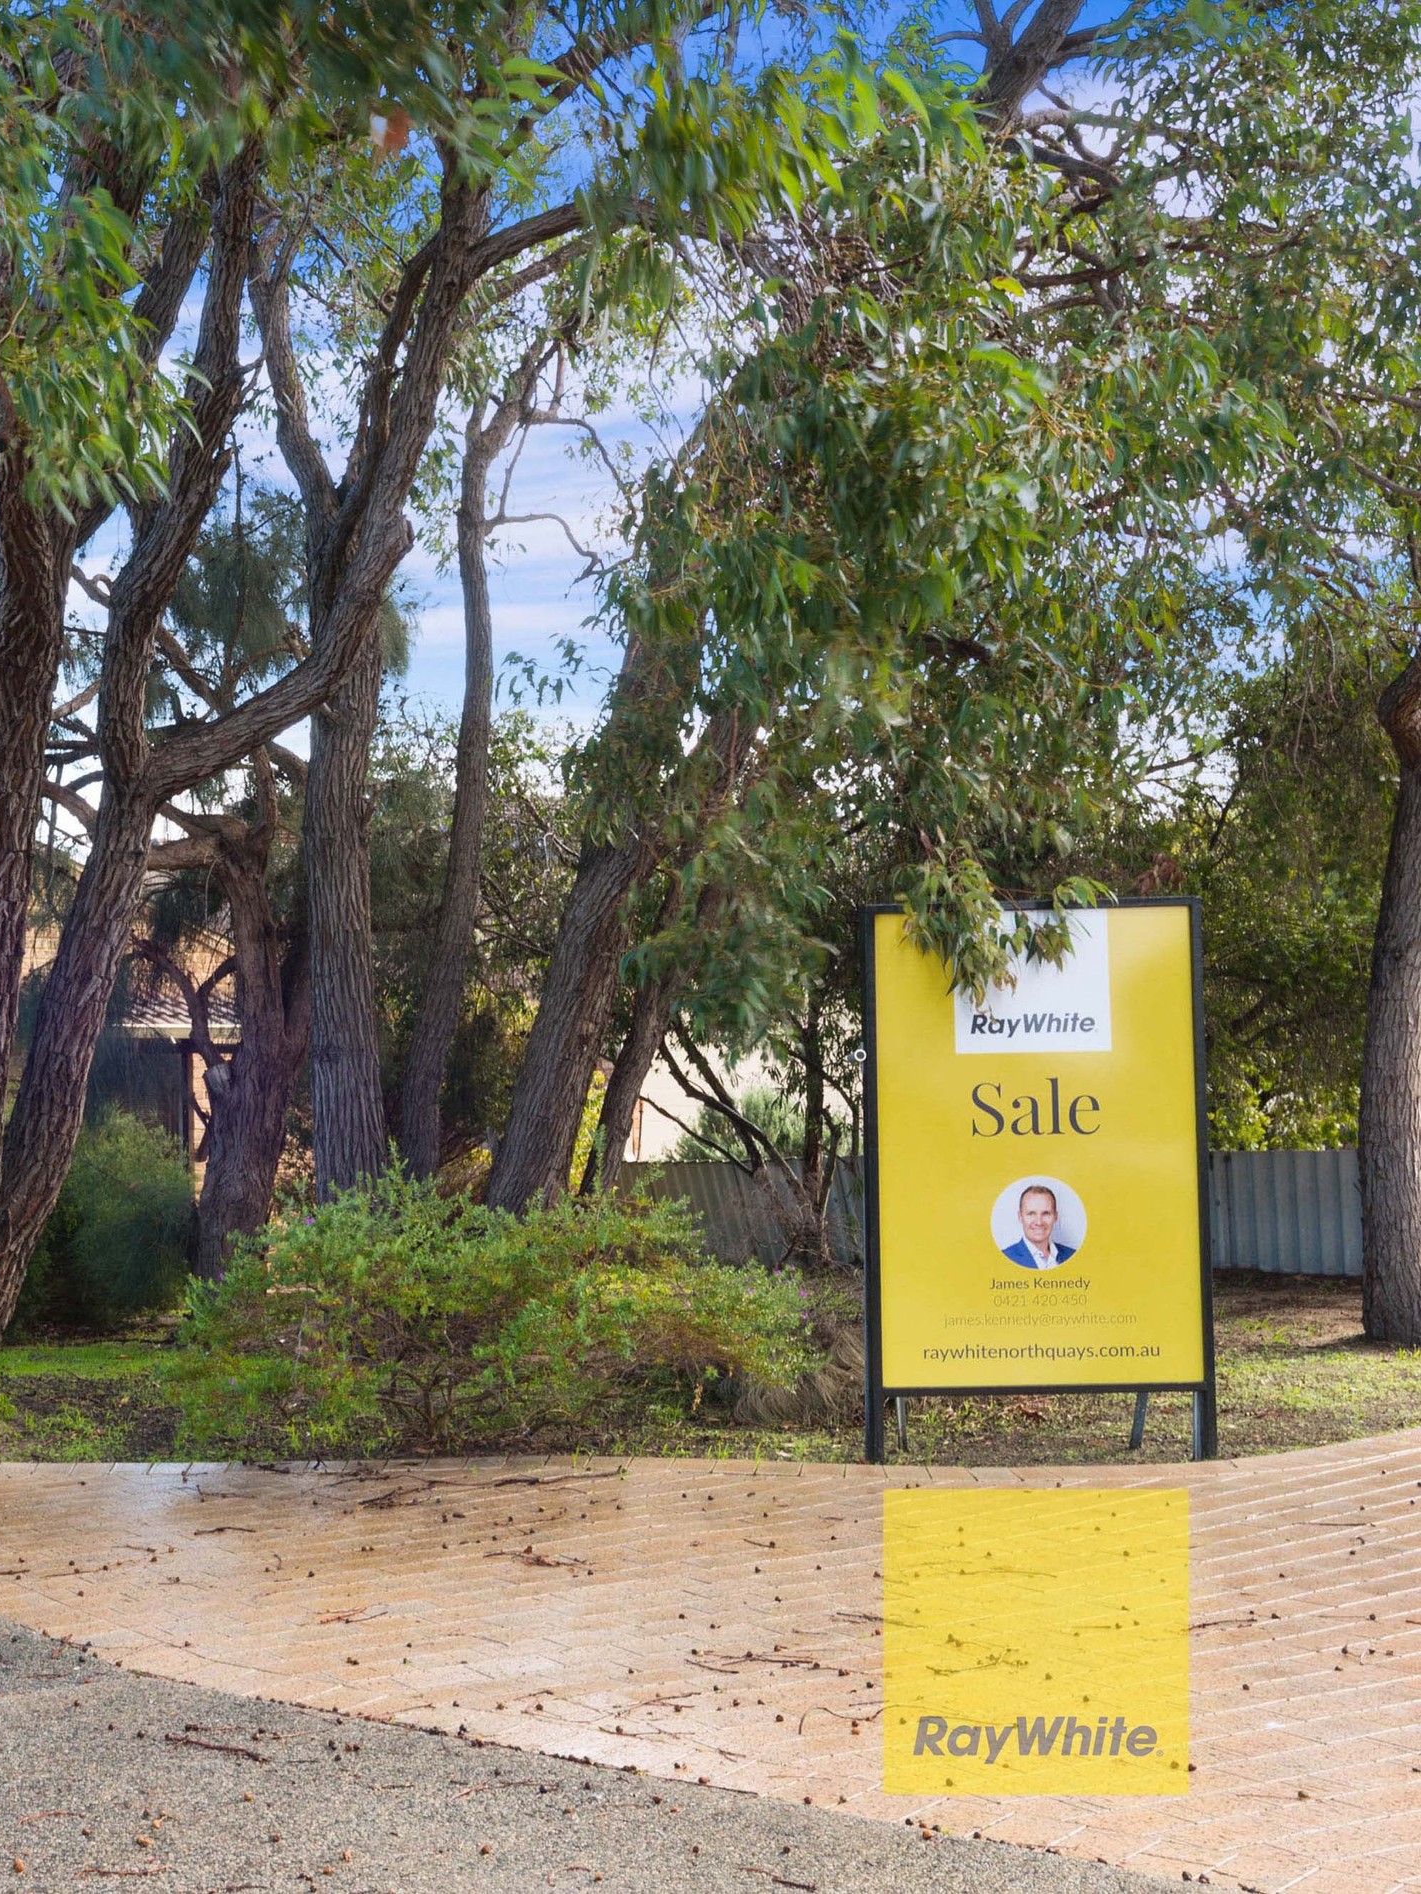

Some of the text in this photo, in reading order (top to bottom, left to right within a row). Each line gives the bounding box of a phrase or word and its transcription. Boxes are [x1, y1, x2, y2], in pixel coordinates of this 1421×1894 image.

[971, 1077, 1100, 1137] Sale
[989, 1276, 1091, 1291] James Kennedy
[993, 1294, 1027, 1307] 0421
[1032, 1294, 1058, 1306] 420
[943, 1313, 1137, 1328] james.kennedy@raywhite.com
[923, 1344, 1160, 1362] raywhitenorthquays.com.au
